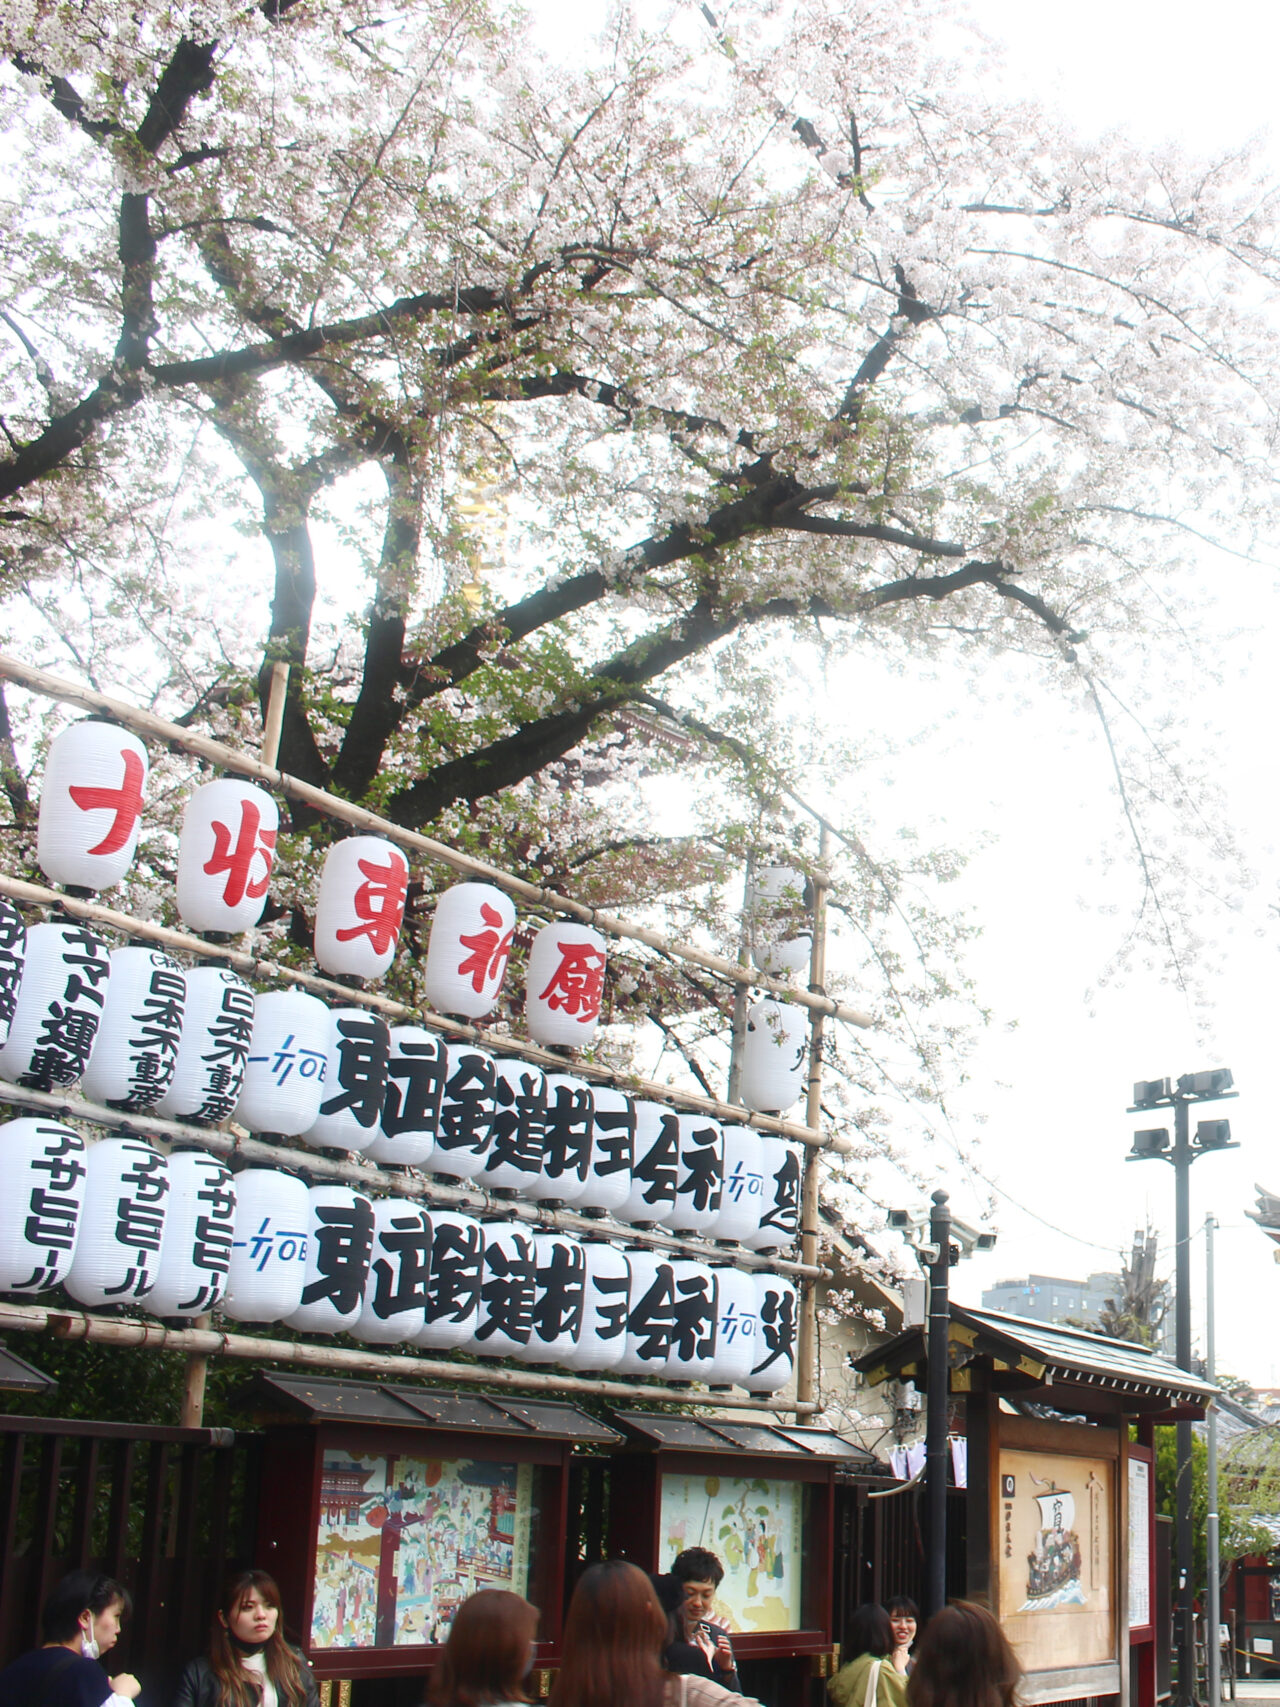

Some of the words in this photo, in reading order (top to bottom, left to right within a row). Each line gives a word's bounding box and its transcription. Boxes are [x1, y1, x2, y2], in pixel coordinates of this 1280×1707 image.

[28, 929, 111, 1088] ヤマト運輸
[11, 1127, 87, 1291] アサヒビール
[104, 1144, 170, 1297] アサヒビール
[178, 1160, 238, 1312] アサヒビール
